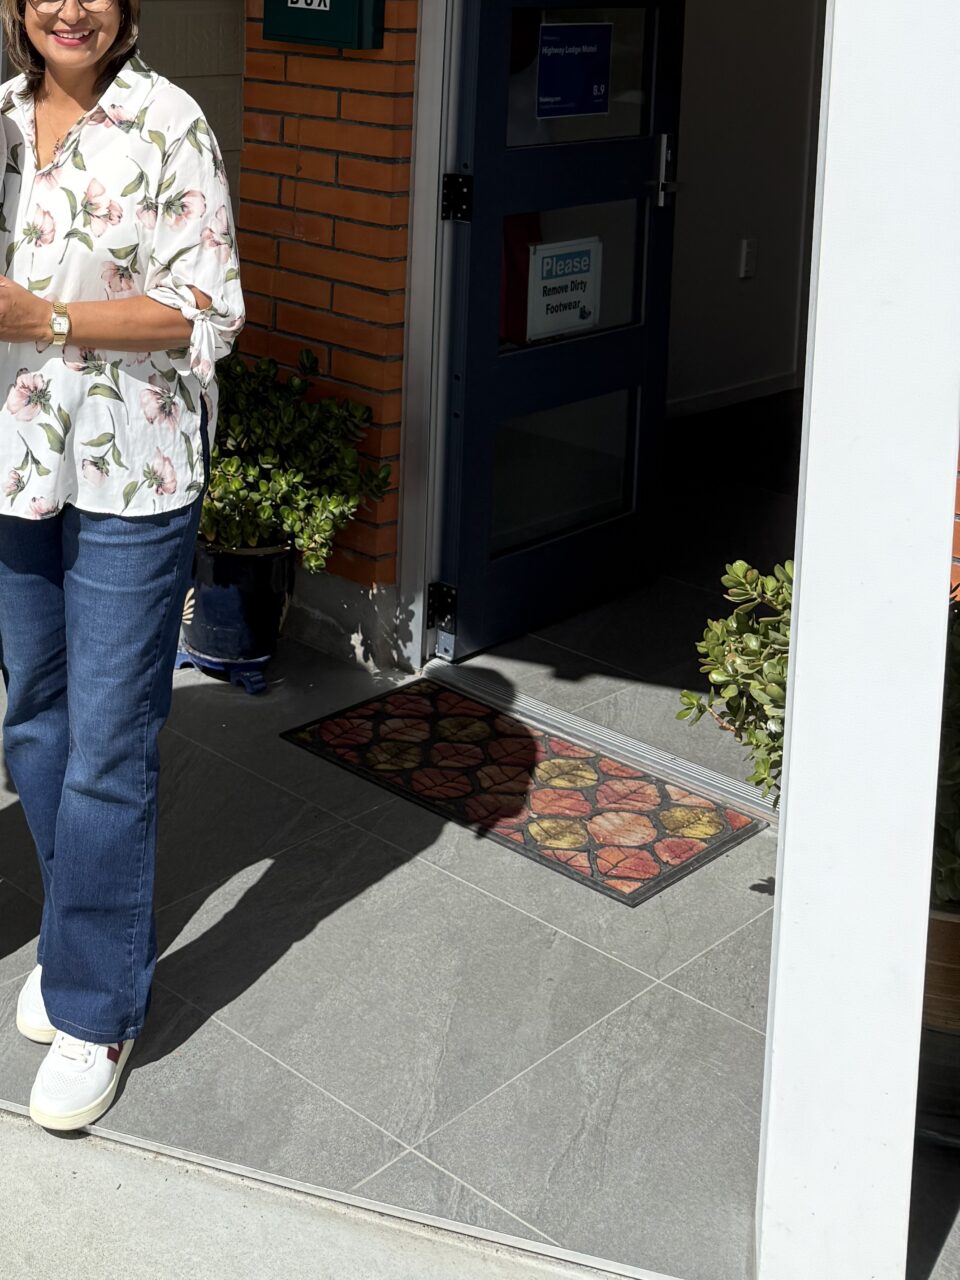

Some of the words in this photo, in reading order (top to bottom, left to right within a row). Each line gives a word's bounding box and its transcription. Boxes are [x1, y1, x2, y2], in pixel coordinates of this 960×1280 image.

[542, 256, 590, 277] Please
[542, 285, 569, 297] Remove
[570, 280, 587, 293] Dirty
[545, 300, 581, 315] Footwear
